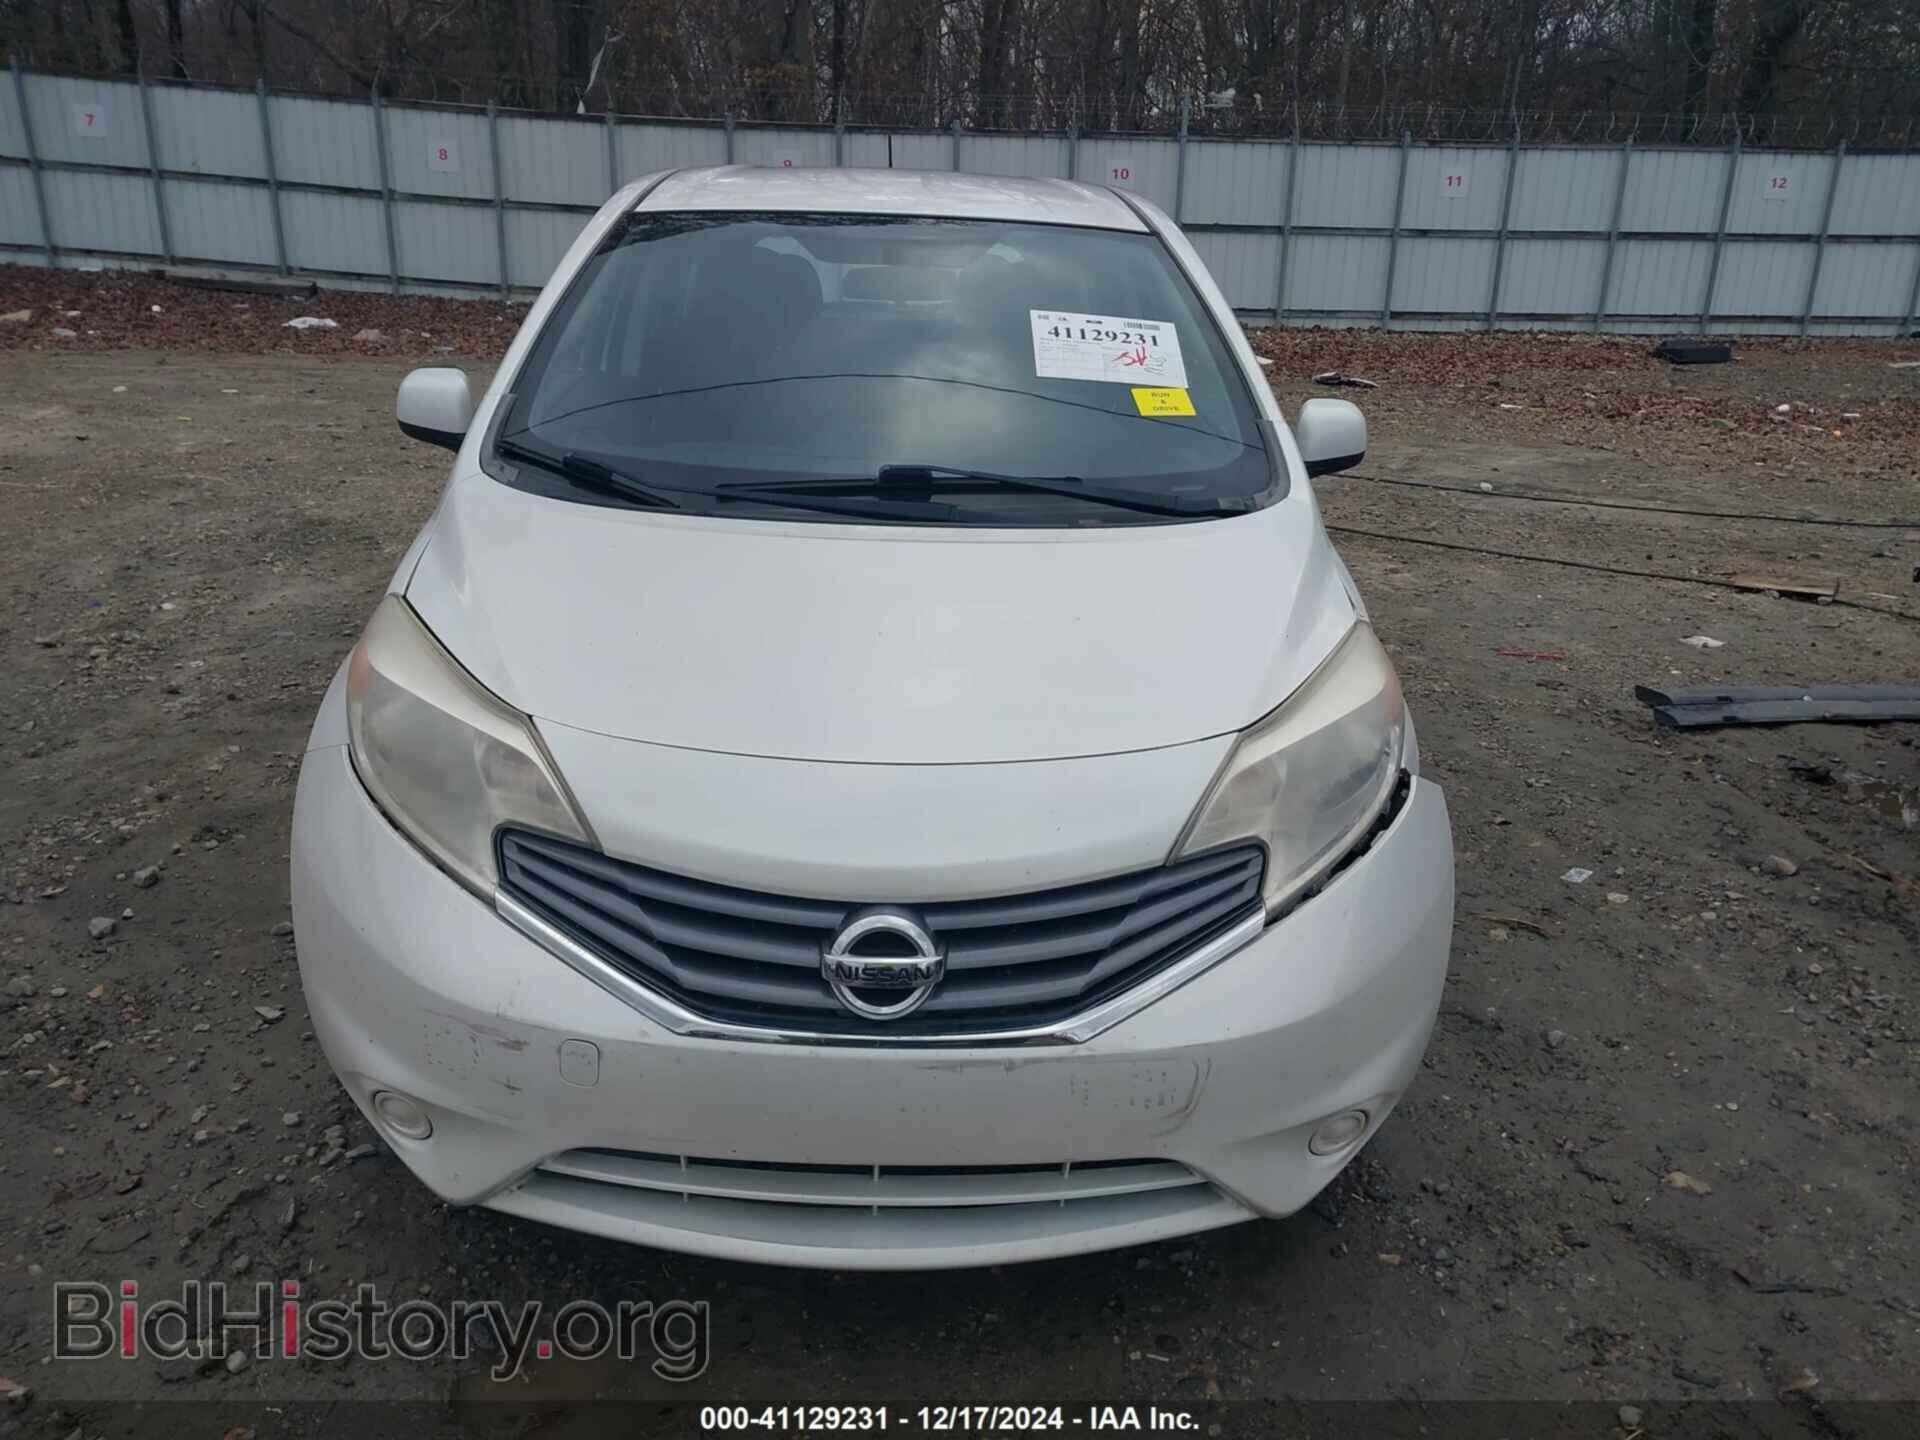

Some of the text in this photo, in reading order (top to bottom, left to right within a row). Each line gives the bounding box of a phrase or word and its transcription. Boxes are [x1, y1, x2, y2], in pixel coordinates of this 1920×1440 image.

[83, 112, 96, 127] 7
[438, 147, 449, 161] 8
[1112, 168, 1129, 180] 10
[1447, 175, 1462, 187] 11
[1770, 177, 1787, 189] 12
[1047, 325, 1159, 347] 41129231
[834, 963, 931, 981] NISSAN
